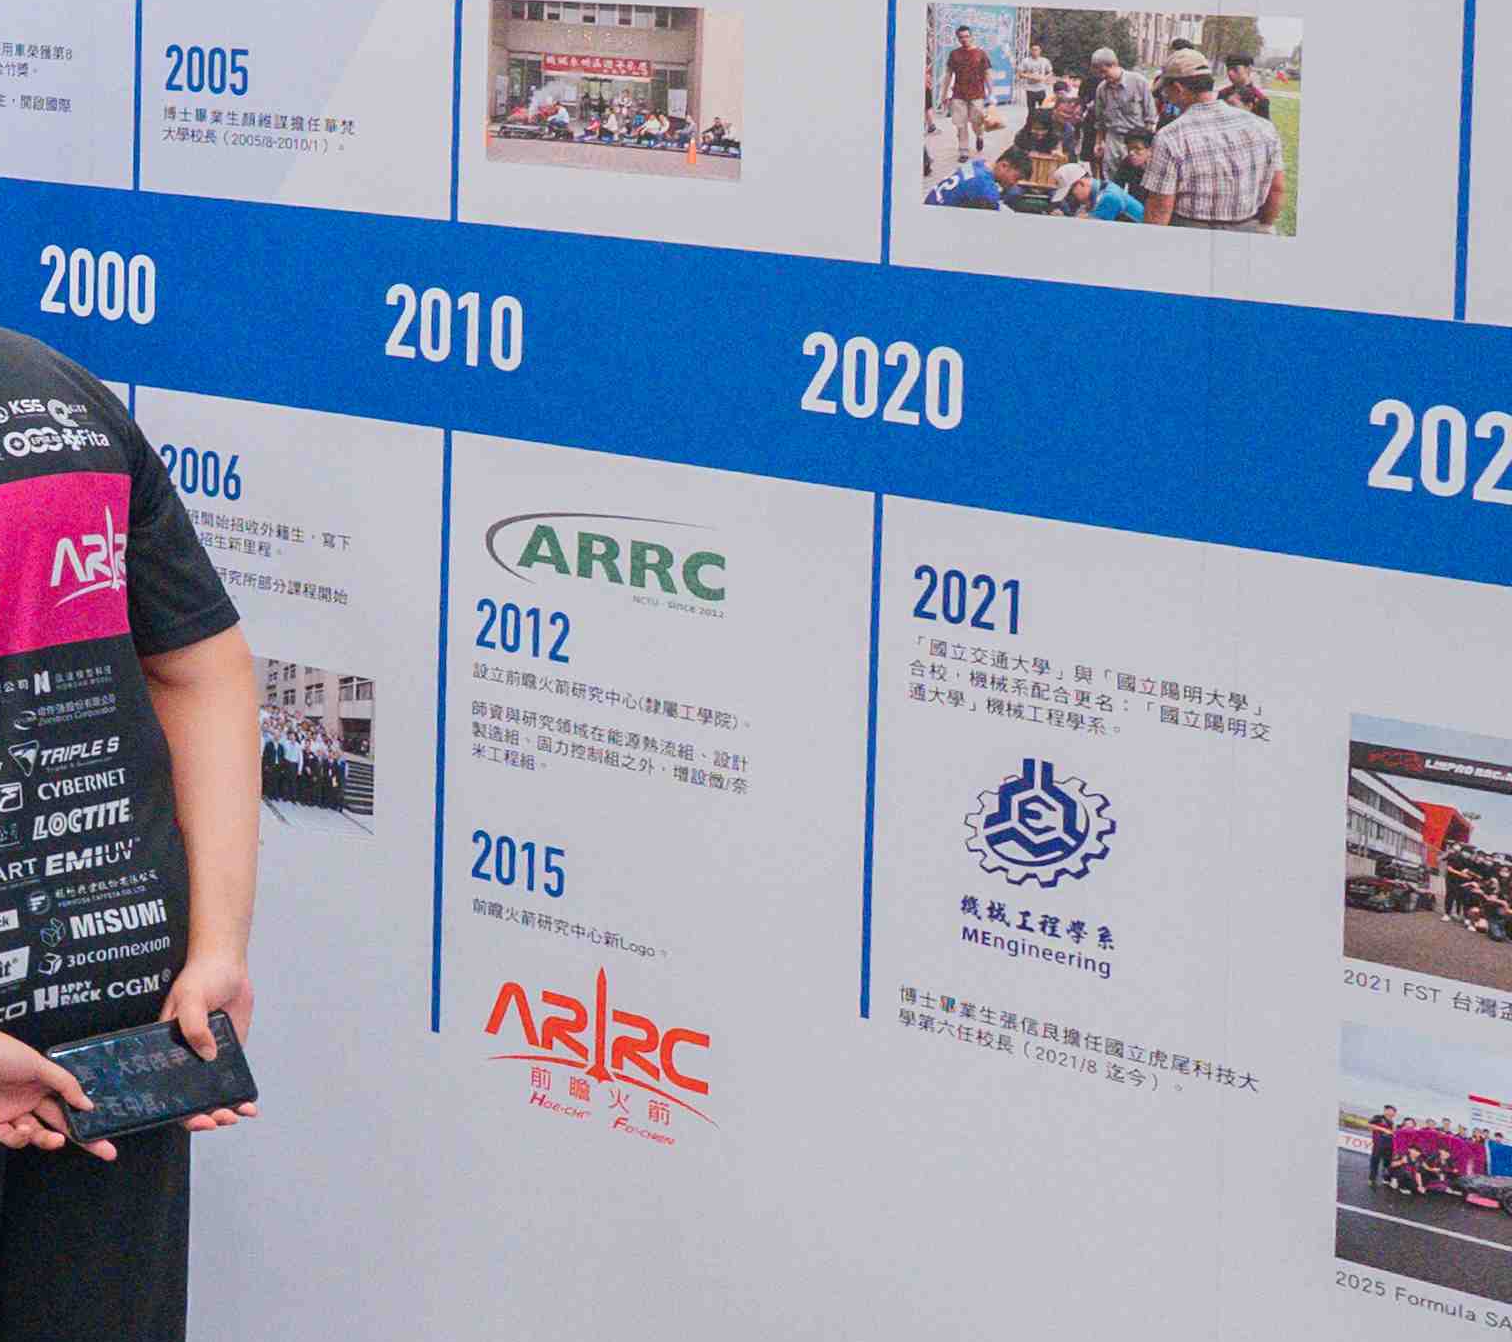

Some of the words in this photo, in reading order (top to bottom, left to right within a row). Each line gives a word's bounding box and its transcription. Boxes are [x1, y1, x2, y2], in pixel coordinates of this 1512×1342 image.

[164, 44, 249, 96] 2005
[41, 244, 156, 325] 2000
[385, 283, 523, 372] 2010
[801, 331, 964, 430] 2020
[159, 444, 241, 501] 2006
[517, 524, 726, 602] ARRC
[912, 564, 1021, 636] 2021
[476, 597, 571, 664] 2012
[40, 739, 104, 766] TRIPLE
[107, 736, 120, 753] S
[37, 767, 126, 801] CYBERNET
[32, 797, 131, 841] LOCTITE
[472, 829, 565, 899] 2015
[960, 894, 1116, 951] 機械工程學系
[961, 926, 1112, 980] MEngineering
[1343, 969, 1392, 993] 2021
[1403, 982, 1441, 1003] FST
[1335, 1270, 1386, 1297] 2025
[1394, 1286, 1476, 1322] Formula
